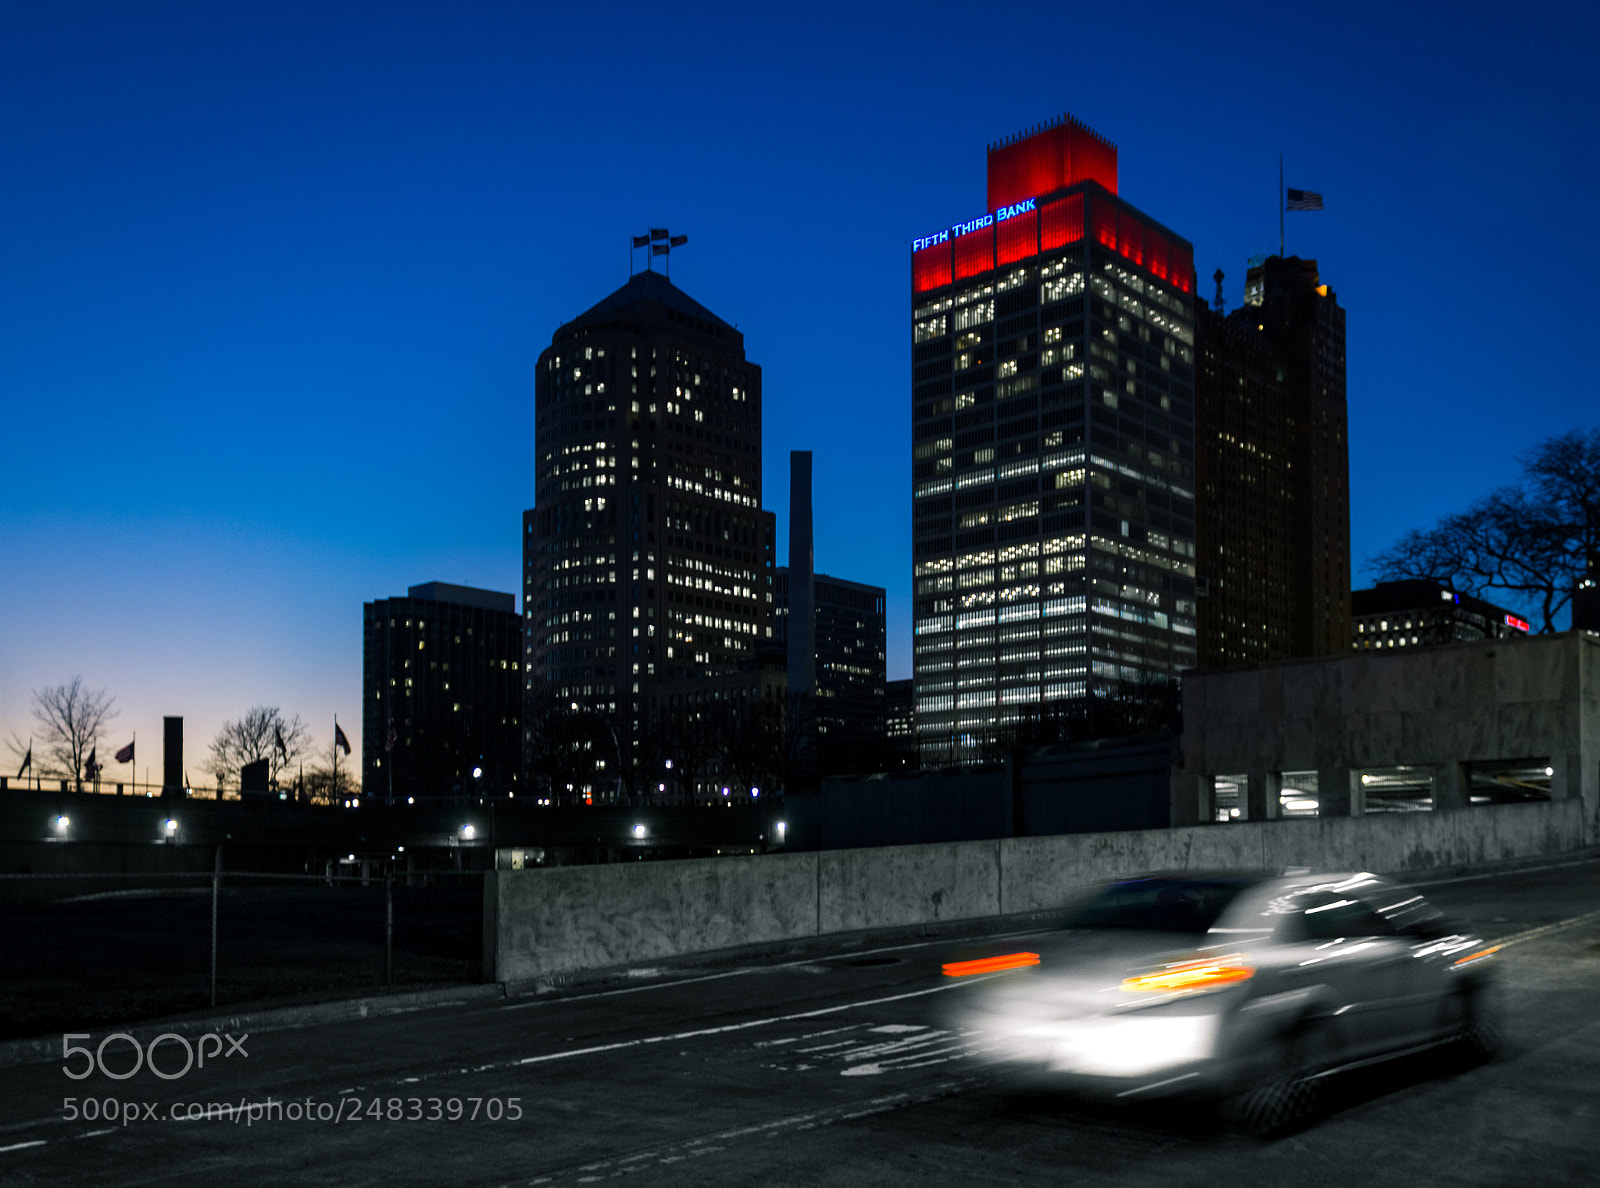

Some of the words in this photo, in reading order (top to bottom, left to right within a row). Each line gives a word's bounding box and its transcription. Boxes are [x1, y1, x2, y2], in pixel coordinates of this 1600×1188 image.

[913, 229, 949, 252] FIFTH
[952, 214, 993, 237] THIRD
[996, 197, 1036, 222] BANK
